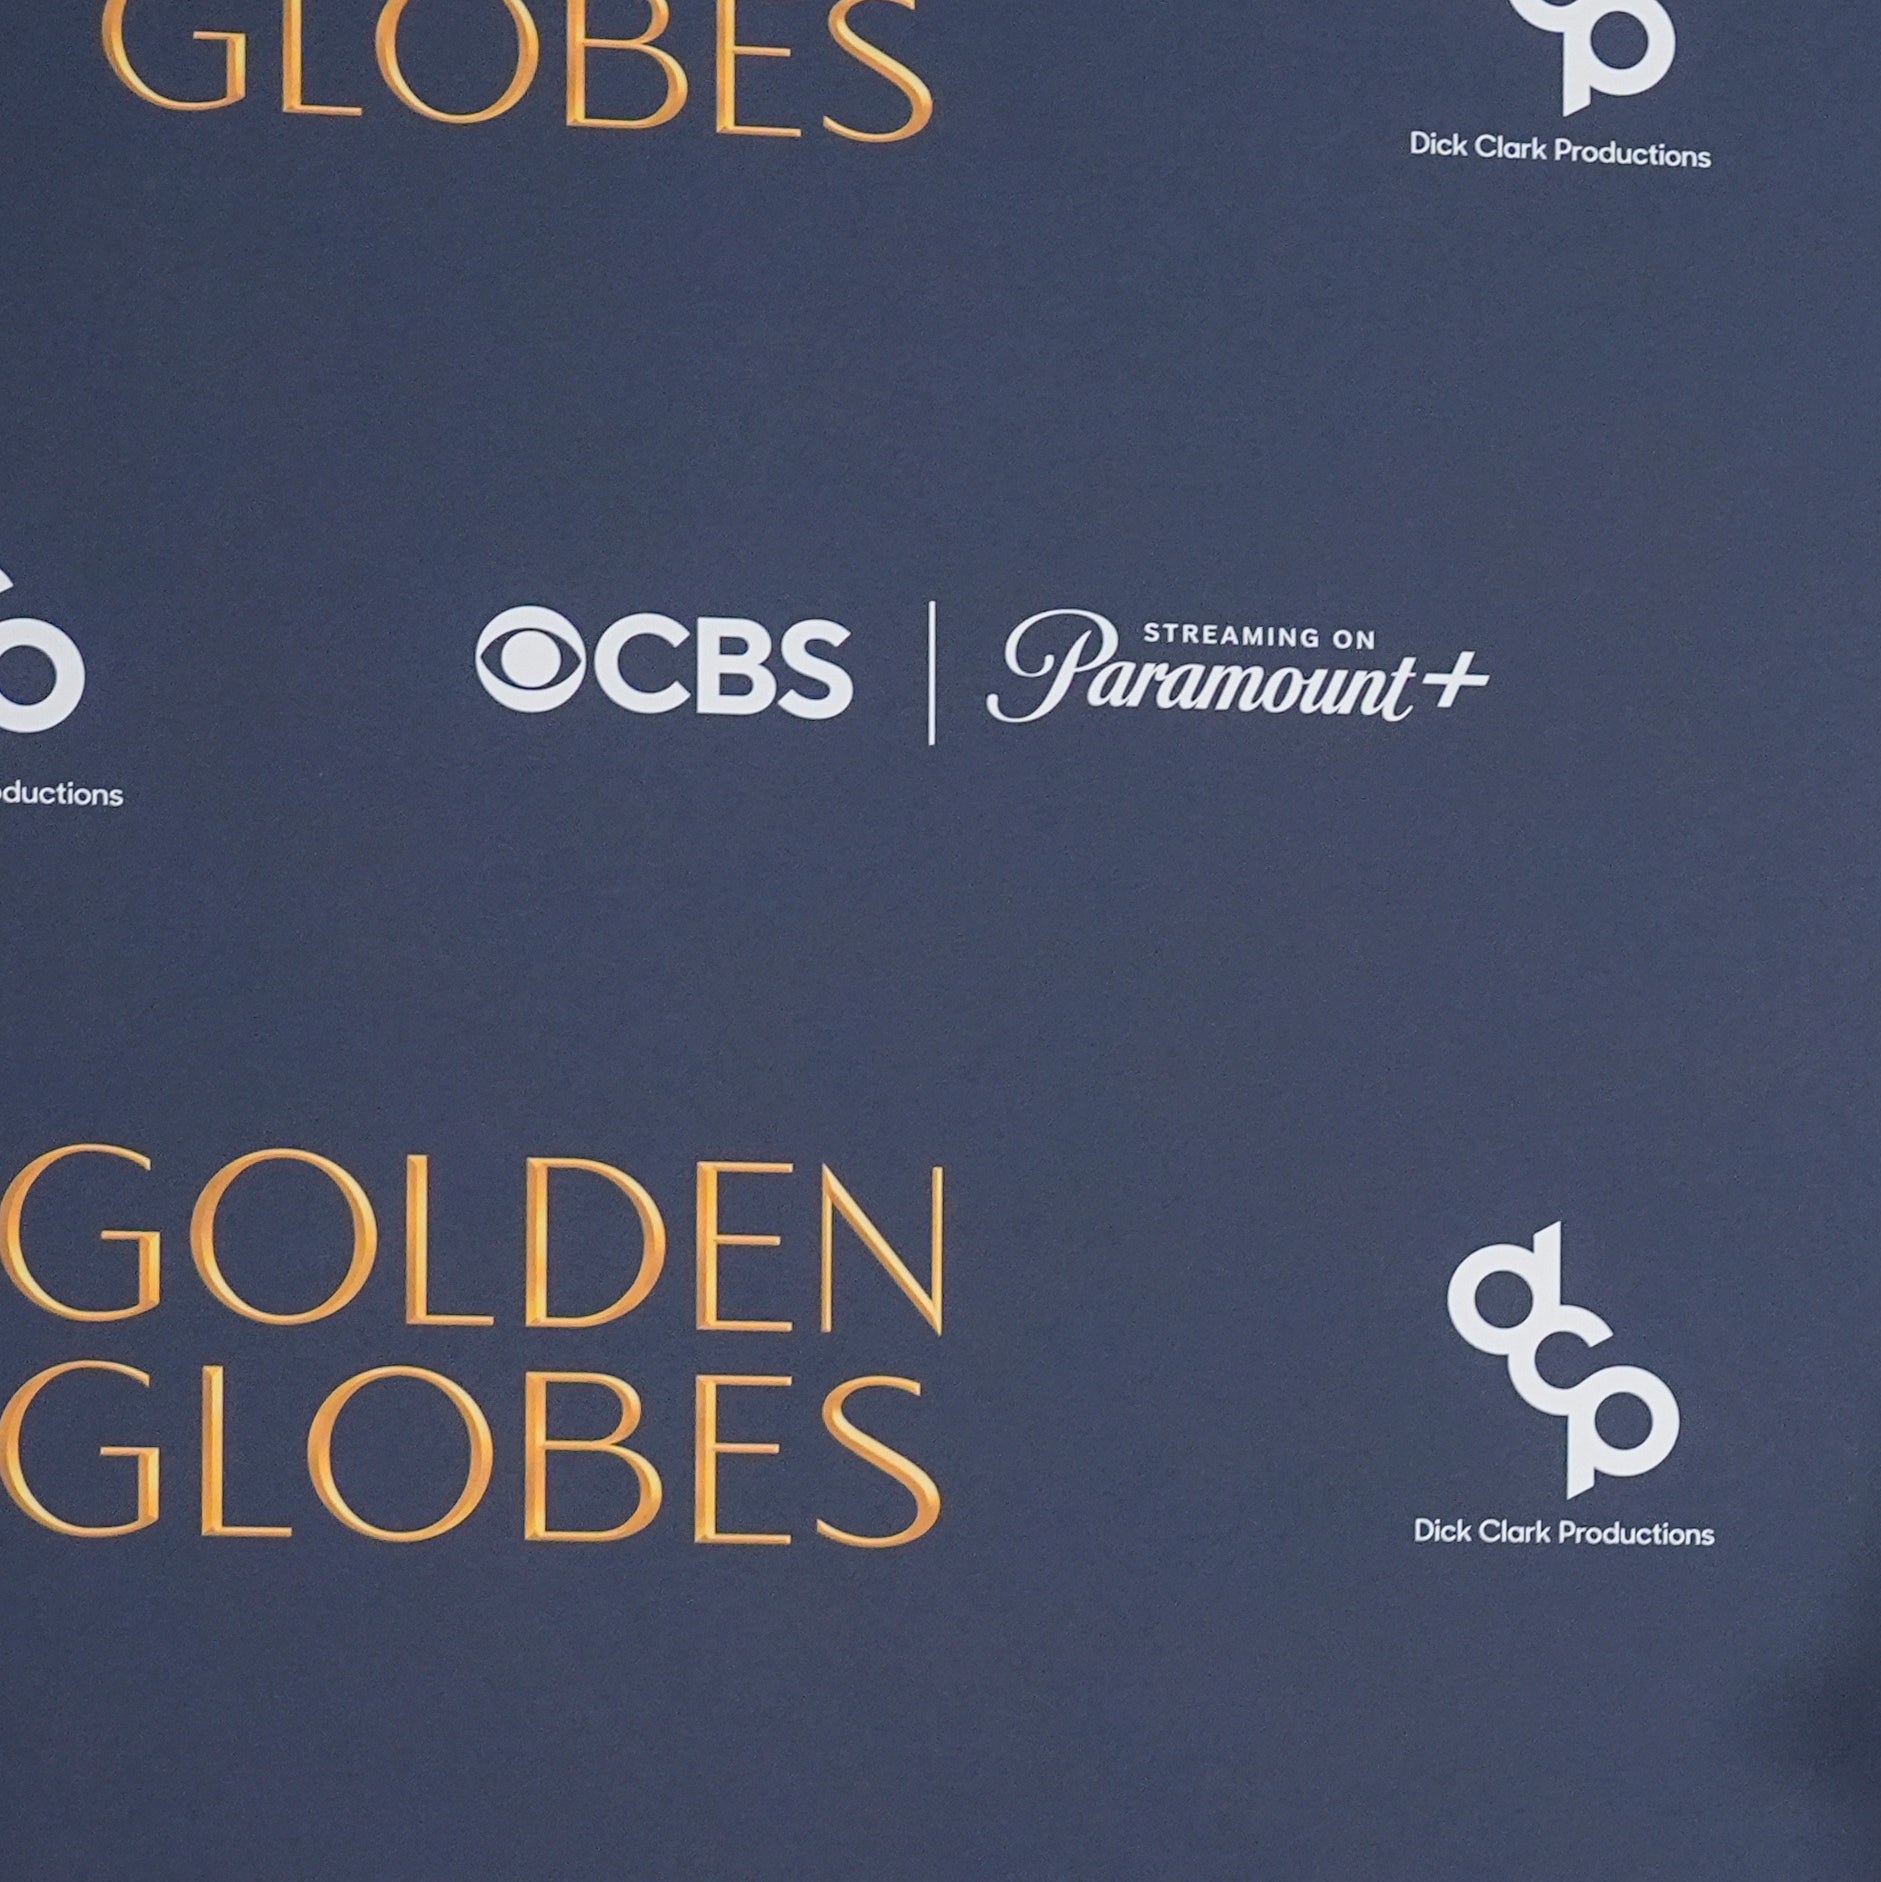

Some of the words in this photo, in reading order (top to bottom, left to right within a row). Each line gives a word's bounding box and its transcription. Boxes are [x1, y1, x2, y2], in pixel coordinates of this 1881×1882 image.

[101, 0, 933, 144] GLOBES
[1410, 131, 1469, 157] Dick
[1475, 134, 1548, 161] Clark
[1555, 138, 1712, 168] Productions
[594, 612, 854, 720] CBS
[1144, 622, 1320, 649] STREAMING
[1332, 629, 1375, 651] ON
[0, 779, 124, 807] ductions
[0, 1142, 944, 1337] GOLDEN
[0, 1359, 942, 1549] GLOBES
[1414, 1517, 1473, 1543] Dick
[1479, 1518, 1552, 1544] Clark
[1558, 1519, 1716, 1546] Productions
